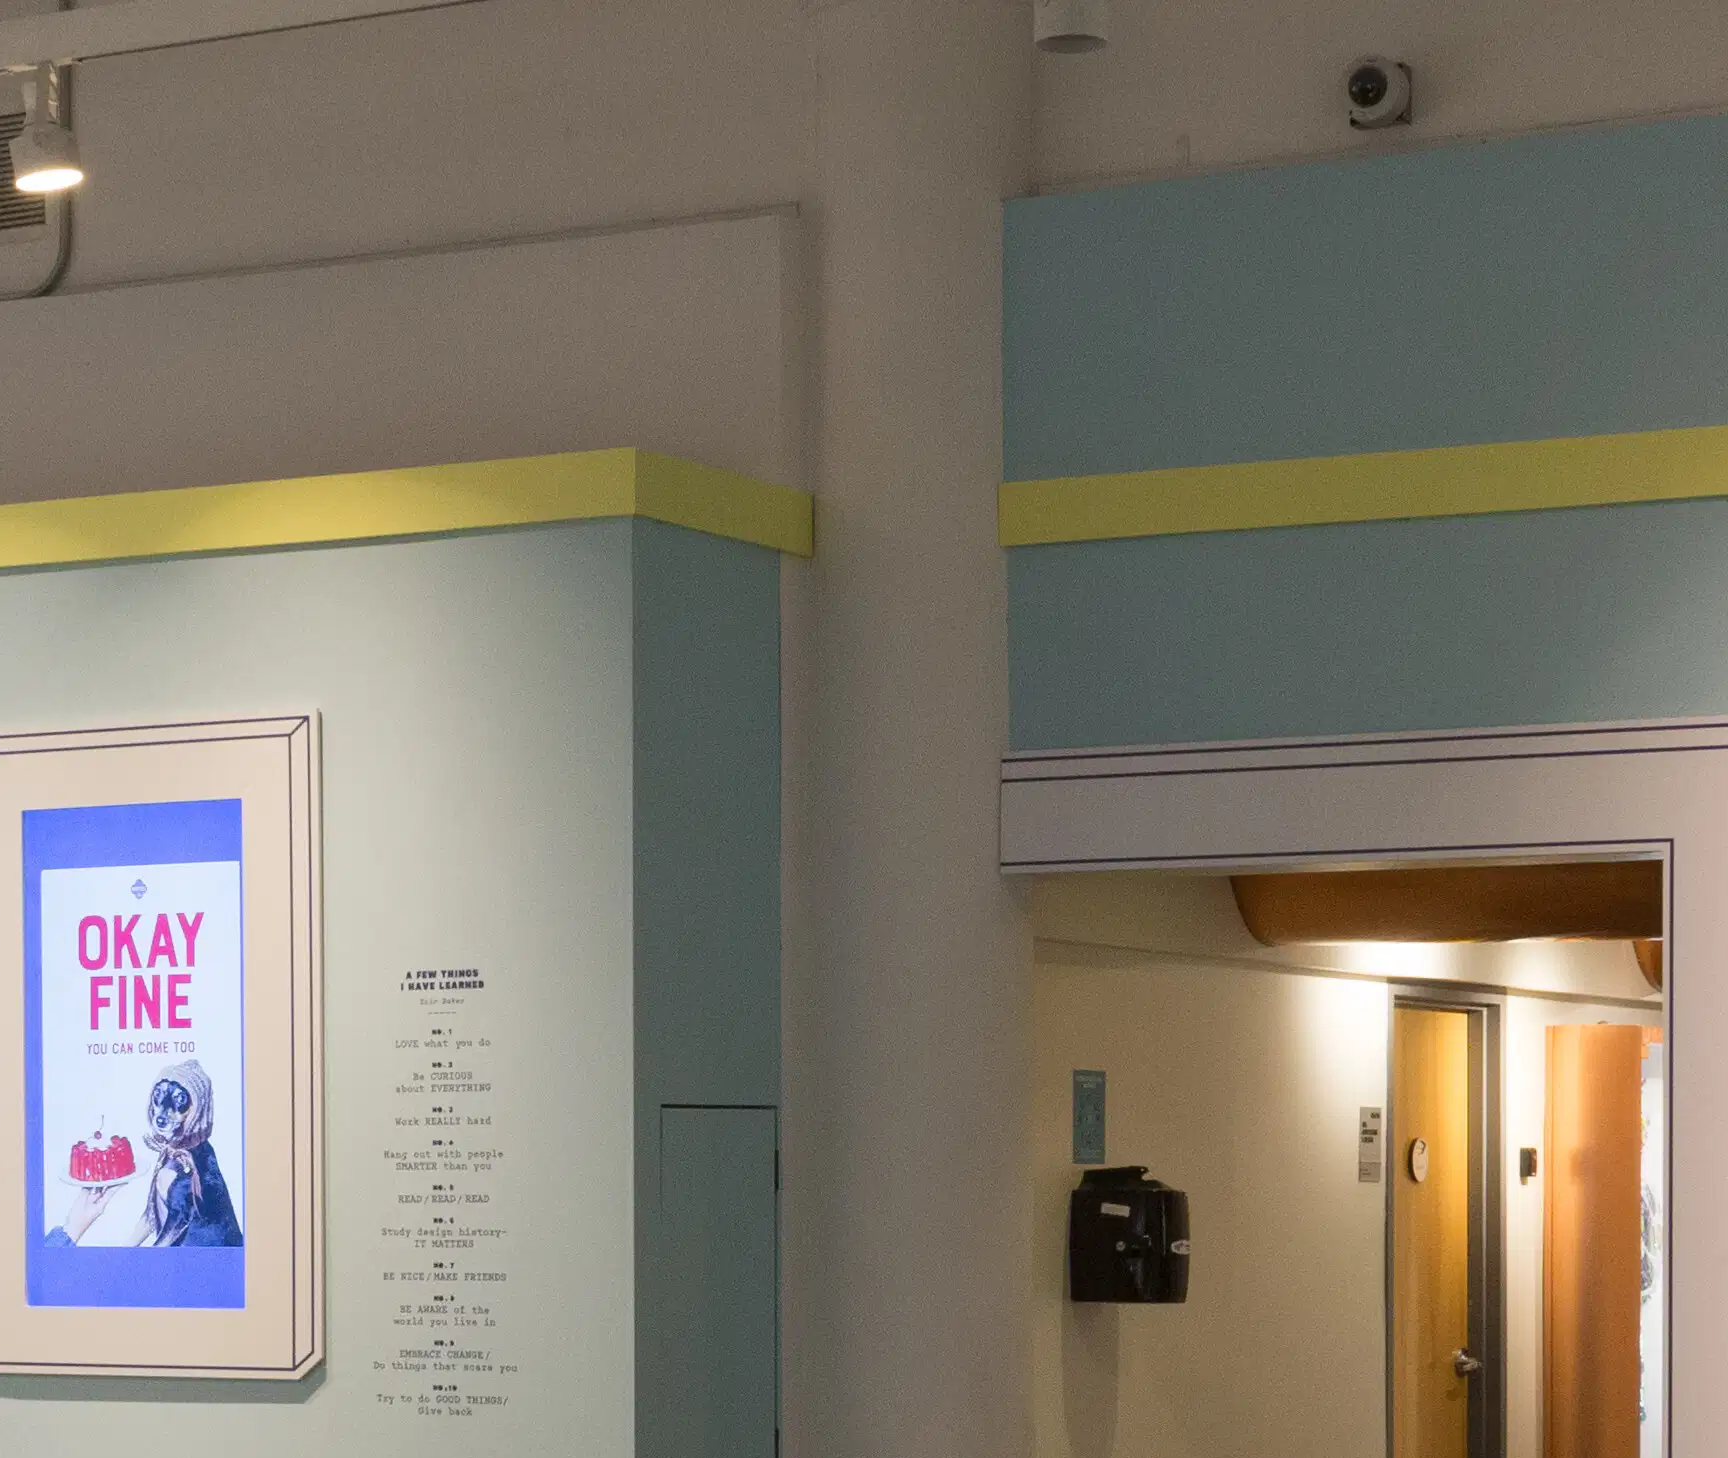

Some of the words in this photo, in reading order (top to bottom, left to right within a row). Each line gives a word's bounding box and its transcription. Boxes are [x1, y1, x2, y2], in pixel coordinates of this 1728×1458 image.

[78, 912, 205, 970] OKAY
[441, 969, 479, 978] THINGS
[408, 982, 435, 991] HAVE
[440, 981, 484, 989] LEARNED
[90, 974, 192, 1030] FINE
[87, 1043, 107, 1055] YOU
[112, 1043, 133, 1054] CAN
[138, 1042, 168, 1054] COME
[174, 1041, 195, 1053] TOO
[395, 1040, 419, 1048] LOVE
[456, 1040, 472, 1049] you
[413, 1073, 424, 1081] Be
[431, 1072, 472, 1080] CURIOUS
[396, 1085, 424, 1093] about
[431, 1084, 491, 1092] EVERYTHING
[395, 1118, 419, 1126] Work
[425, 1117, 461, 1125] REALLY
[467, 1117, 491, 1125] hard
[384, 1151, 407, 1160] Hang
[437, 1150, 461, 1158] with
[468, 1151, 503, 1159] people
[474, 1163, 491, 1172] you
[381, 1228, 411, 1237] Study
[417, 1228, 452, 1237] design
[432, 1240, 474, 1248] MATTERS
[464, 1273, 507, 1281] FRIENDS
[417, 1306, 447, 1314] AWARE
[454, 1306, 466, 1314] of
[472, 1306, 489, 1314] the
[393, 1318, 423, 1326] world
[430, 1319, 447, 1327] you
[454, 1318, 477, 1326] live
[484, 1318, 495, 1326] in
[392, 1362, 426, 1371] things
[433, 1362, 456, 1370] that
[500, 1364, 517, 1373] you
[377, 1394, 394, 1403] Try
[401, 1395, 412, 1403] to
[418, 1395, 430, 1403] do
[418, 1407, 442, 1415] Give
[448, 1408, 472, 1416] back
